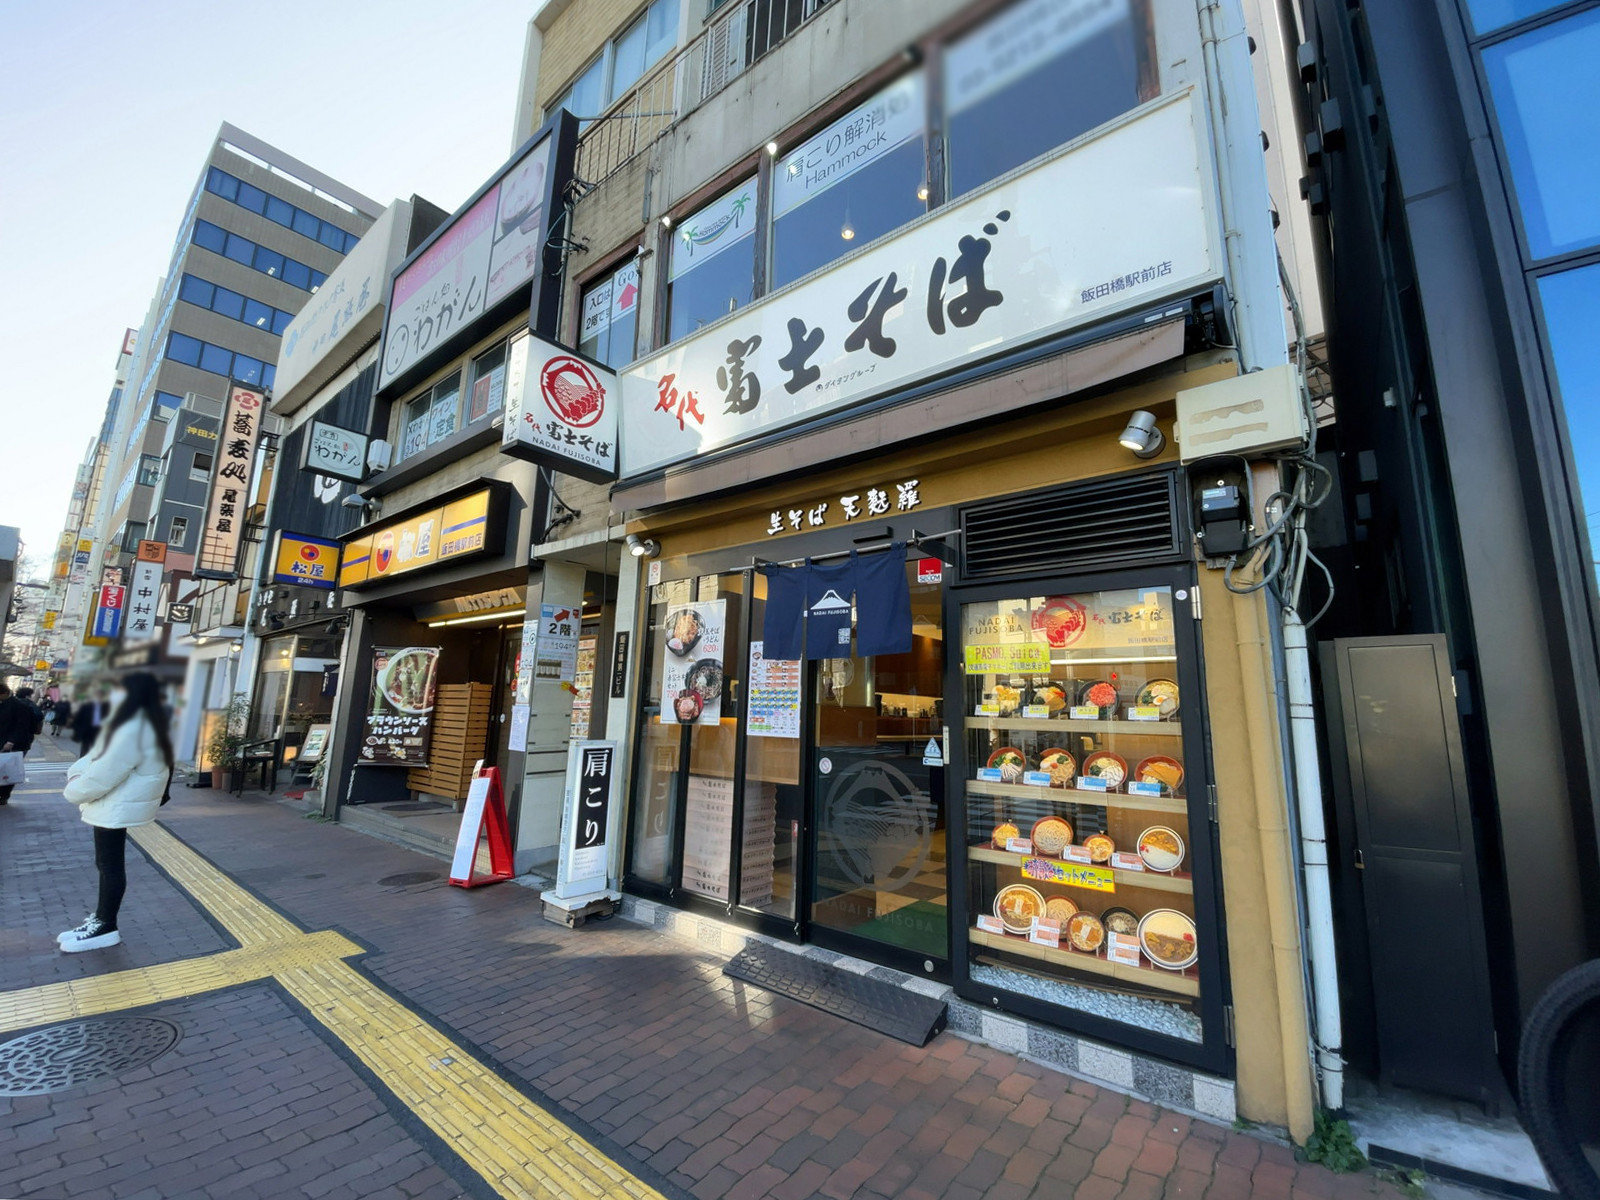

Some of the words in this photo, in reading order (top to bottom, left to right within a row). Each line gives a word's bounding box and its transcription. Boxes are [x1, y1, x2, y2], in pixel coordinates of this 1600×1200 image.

[805, 131, 887, 189] Hammock
[1080, 260, 1172, 304] 飯田橋駅前店
[589, 288, 611, 311] 入口は
[654, 373, 705, 431] 名代
[716, 210, 1011, 416] 富士そば
[532, 436, 561, 452] NADAI
[563, 447, 602, 467] FUJISOBA
[546, 421, 614, 458] 富士そば
[216, 489, 238, 534] 尾張屋
[767, 503, 829, 536] 生そば
[291, 561, 325, 577] 松屋
[128, 586, 153, 631] 中村屋
[978, 616, 1015, 627] NADAI
[548, 622, 572, 637] 2階
[969, 624, 1024, 636] FUJISOBA
[367, 715, 429, 726] ブラウンソース
[371, 725, 420, 736] ハンバーグ
[584, 750, 610, 846] 肩こり
